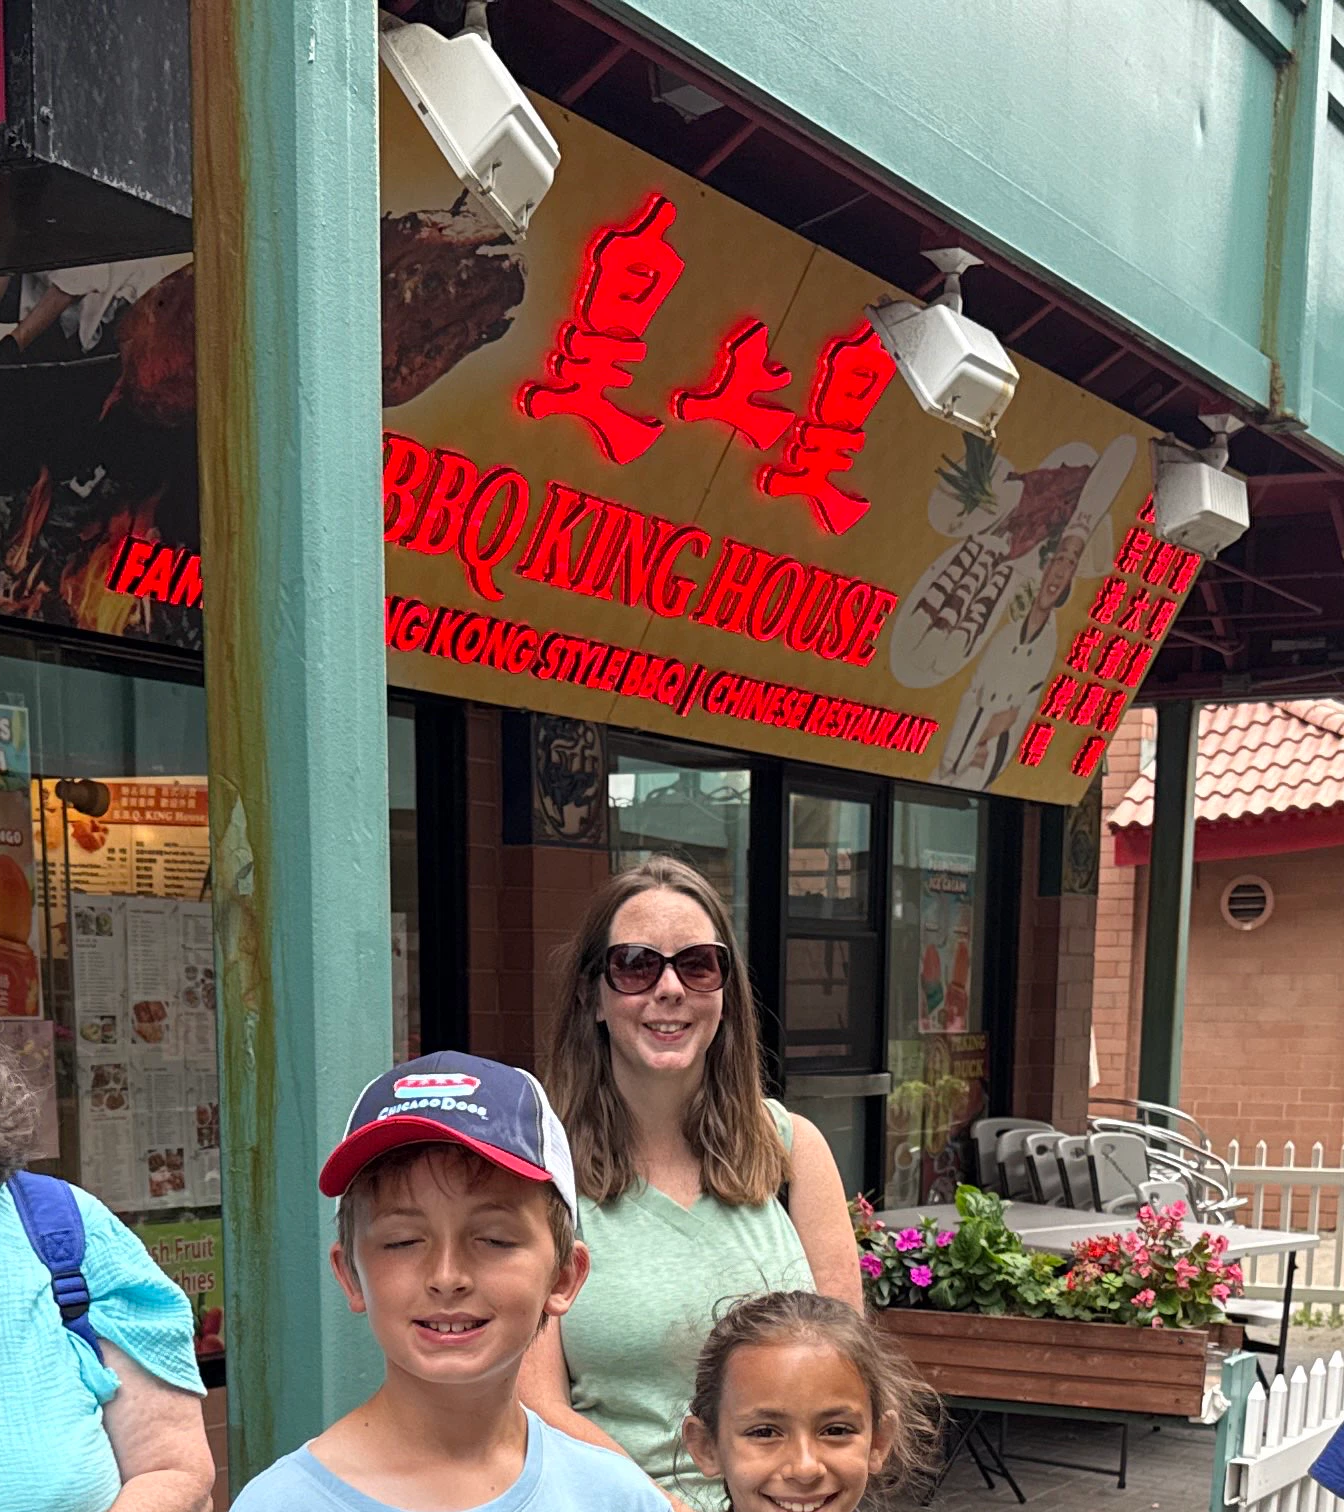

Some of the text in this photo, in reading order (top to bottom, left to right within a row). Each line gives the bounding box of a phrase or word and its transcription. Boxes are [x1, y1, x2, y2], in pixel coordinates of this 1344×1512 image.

[383, 432, 900, 668] BBQ KING HOUSE
[427, 605, 539, 675] KONG
[536, 631, 625, 694] STYLE
[616, 646, 685, 712] BBQ
[702, 670, 809, 730] CHINESE
[804, 697, 940, 755] RESTAURANT
[144, 810, 174, 822] KING
[175, 1237, 214, 1259] Fruit
